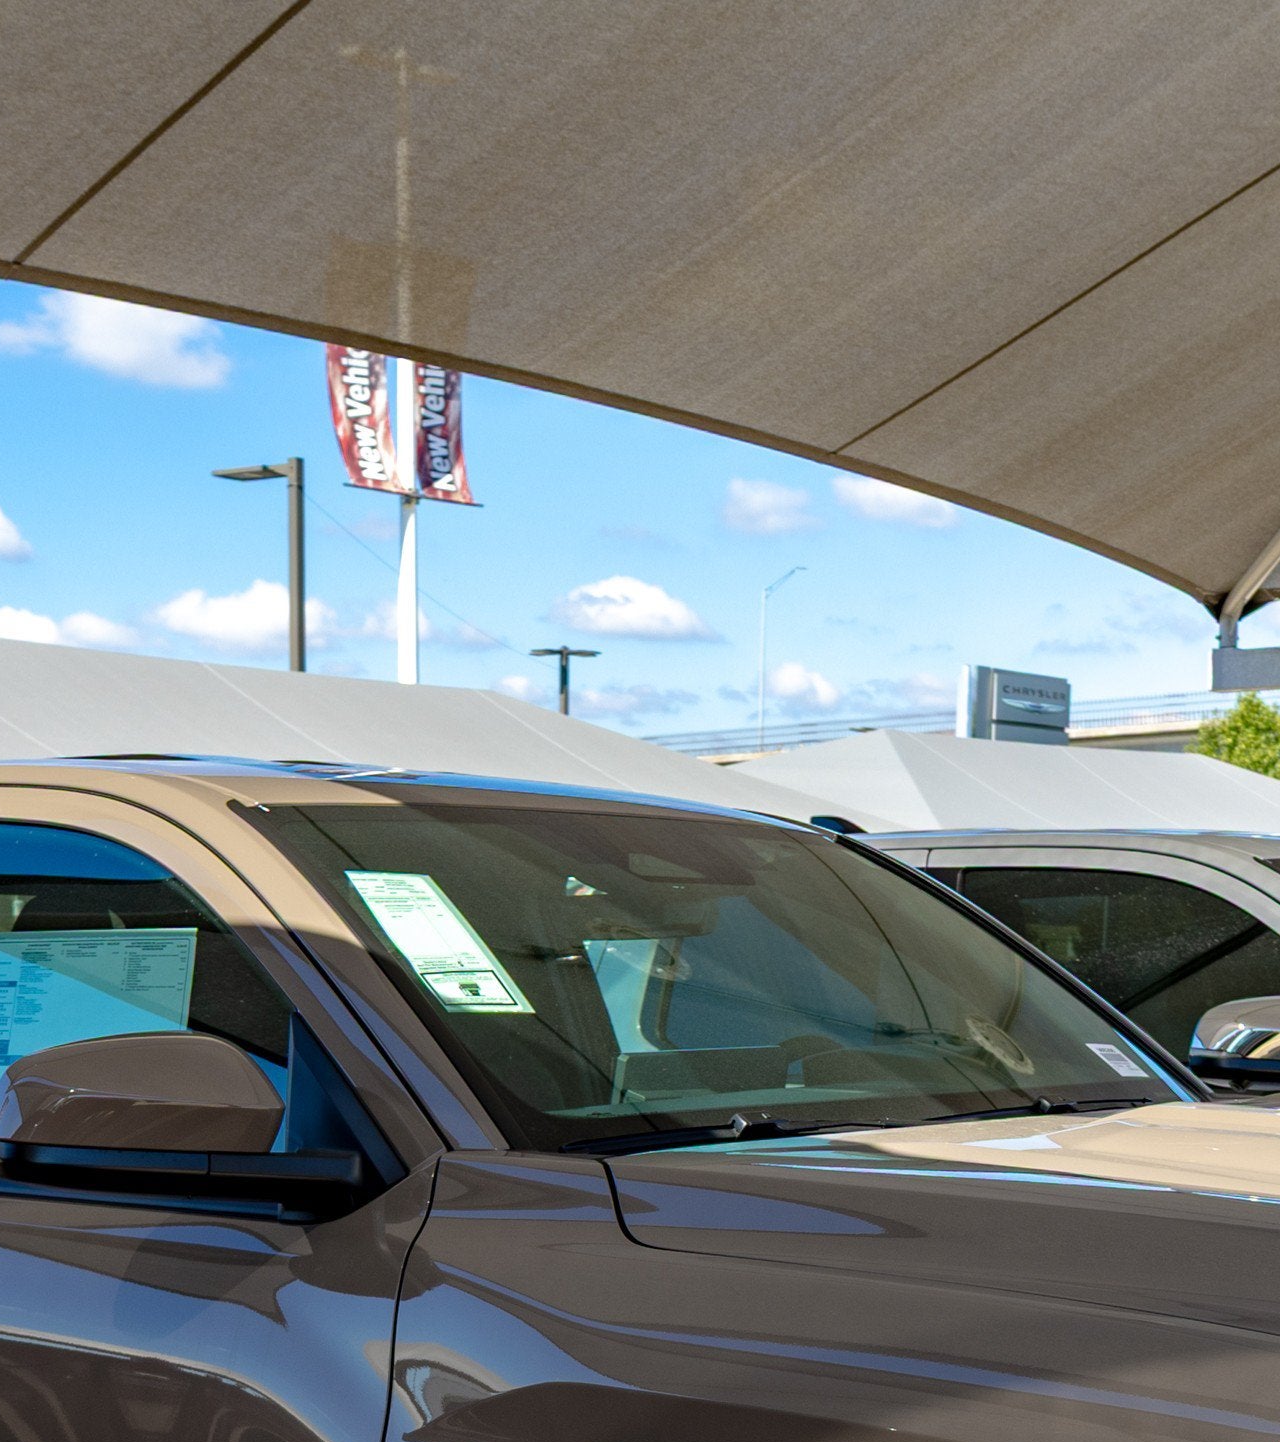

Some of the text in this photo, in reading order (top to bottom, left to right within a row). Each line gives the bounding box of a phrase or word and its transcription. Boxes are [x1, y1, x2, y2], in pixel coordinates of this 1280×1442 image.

[352, 420, 389, 482] New
[417, 363, 457, 491] New Vehi
[1002, 684, 1067, 700] CHRYSLER
